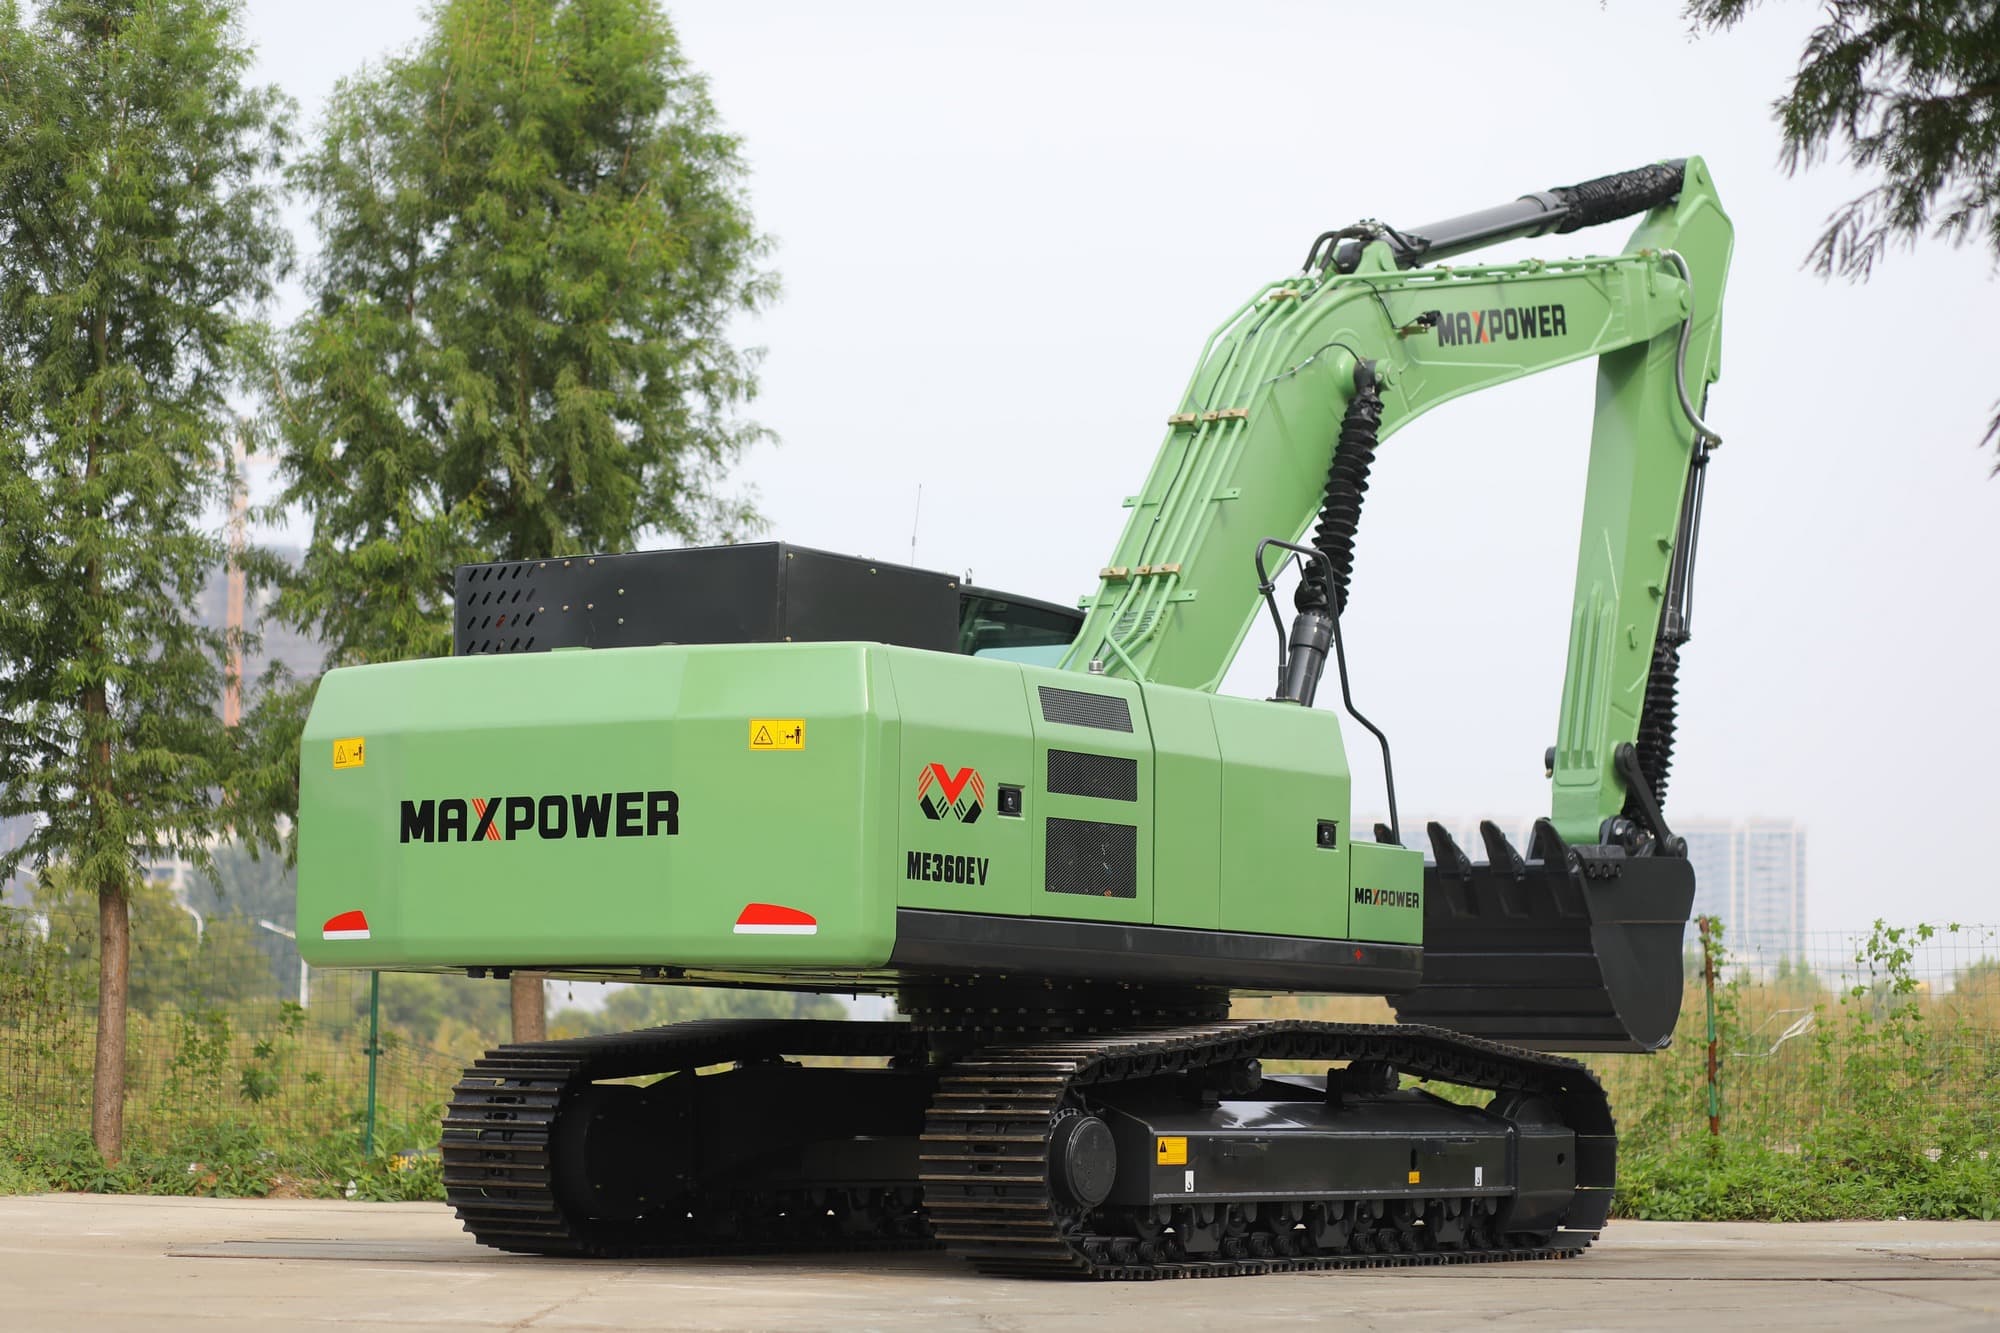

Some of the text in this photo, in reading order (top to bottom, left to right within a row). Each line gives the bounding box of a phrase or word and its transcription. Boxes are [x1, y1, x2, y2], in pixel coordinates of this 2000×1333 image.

[1438, 304, 1567, 347] MAXPOWER
[400, 790, 679, 843] MAXPOWER
[907, 850, 989, 886] ME360EV
[1354, 887, 1419, 909] MAXPOWER
